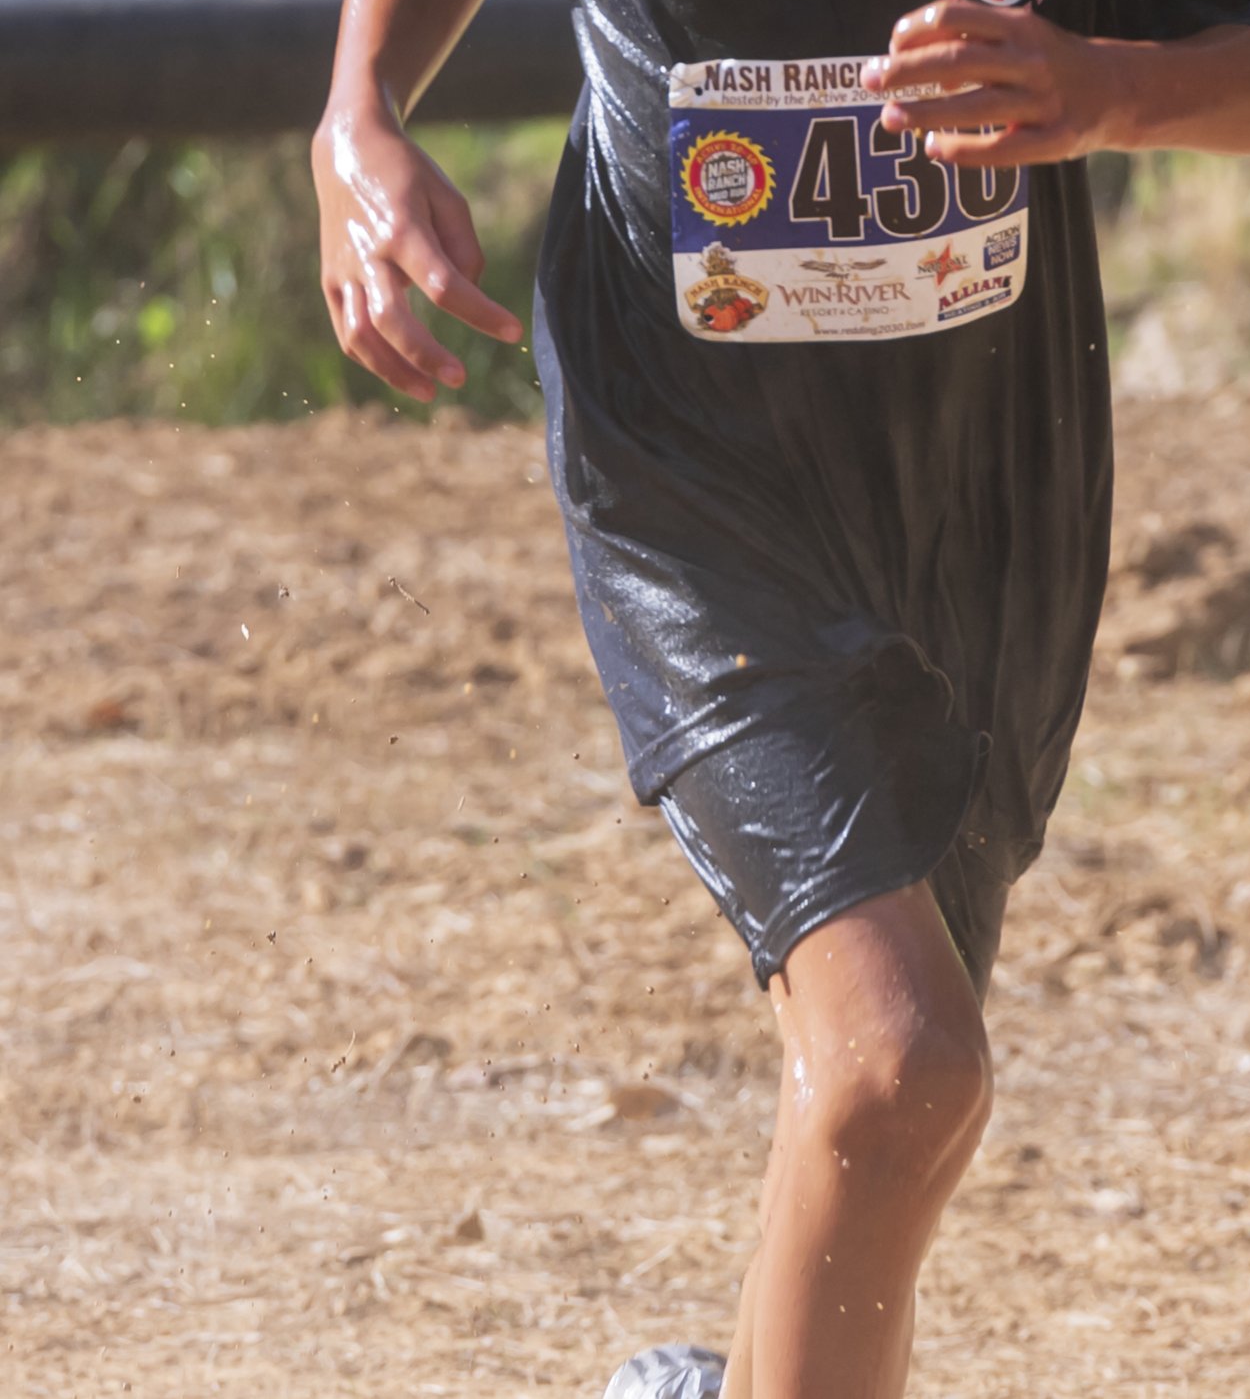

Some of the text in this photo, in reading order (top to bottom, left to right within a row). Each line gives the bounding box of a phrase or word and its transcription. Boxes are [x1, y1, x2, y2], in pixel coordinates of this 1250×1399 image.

[704, 63, 772, 92] NASH
[721, 93, 765, 105] hosted
[766, 93, 780, 107] by
[784, 92, 804, 105] the
[807, 91, 848, 105] Active
[851, 89, 890, 102] 20-30
[893, 84, 921, 99] Club
[708, 158, 745, 178] NASH
[708, 173, 746, 191] RANCH
[985, 225, 1021, 244] ACTION
[938, 275, 1013, 312] ALLIAN
[800, 307, 838, 317] RESORT
[847, 305, 890, 317] CASINO
